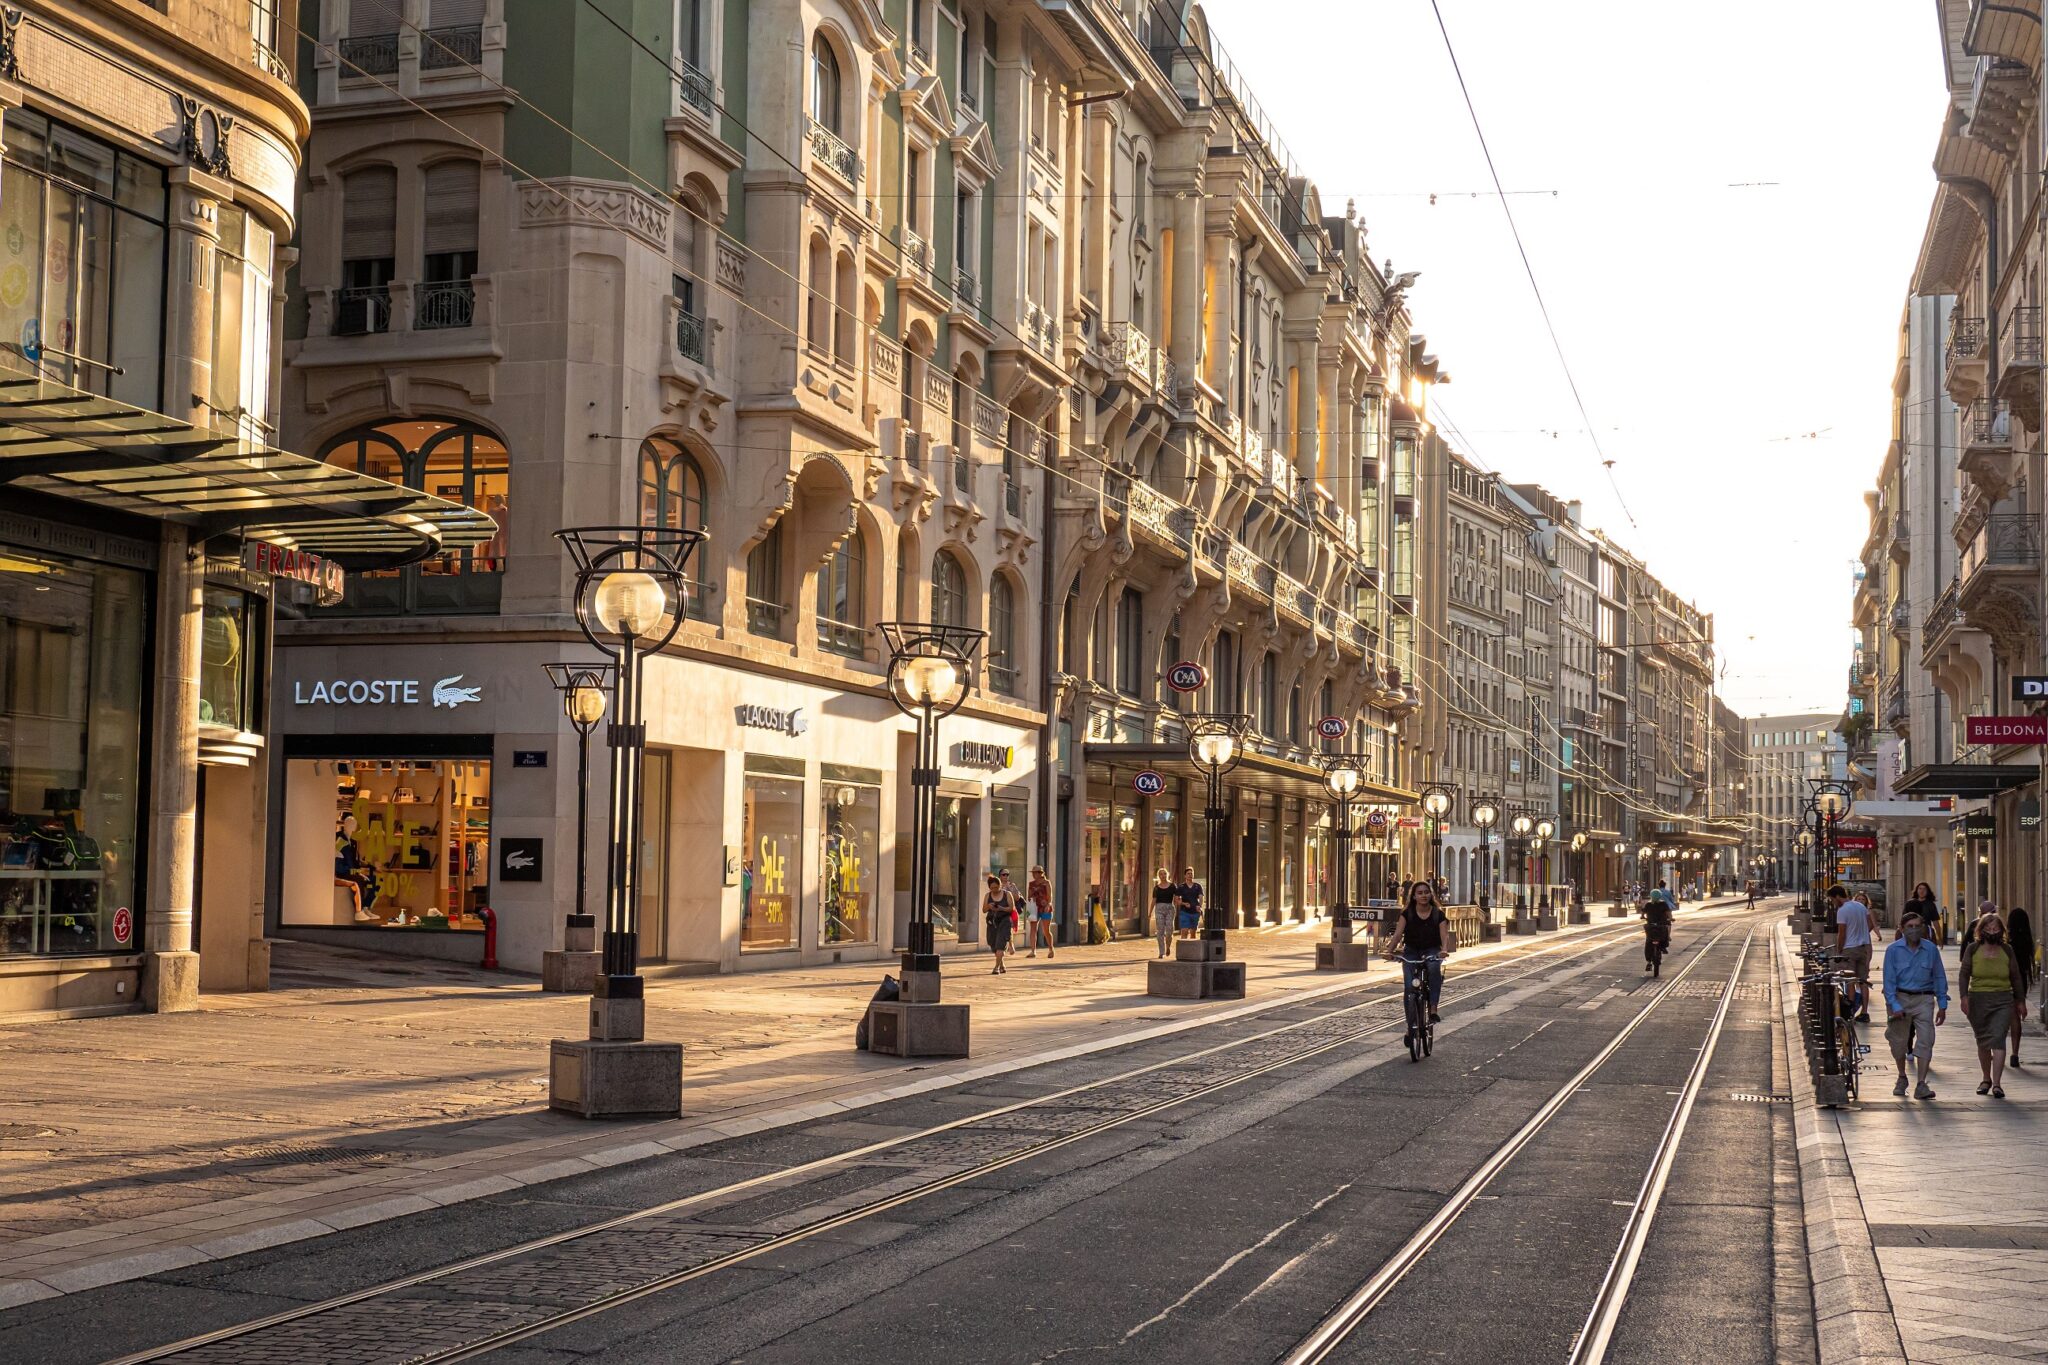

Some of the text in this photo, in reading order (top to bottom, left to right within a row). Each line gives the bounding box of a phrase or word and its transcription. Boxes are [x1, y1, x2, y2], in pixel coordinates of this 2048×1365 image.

[255, 542, 322, 586] FRANZ
[1173, 670, 1198, 684] C&A
[295, 680, 419, 704] LACOSTE
[745, 704, 790, 731] LACOSTE
[1322, 722, 1341, 733] C&A
[1974, 725, 2045, 736] BELDONA
[965, 741, 1006, 768] BLUE LEMON
[1137, 776, 1159, 789] C&A
[352, 798, 420, 865] SALE
[1967, 827, 1994, 835] ESPRIT
[761, 836, 785, 894] SALE
[840, 838, 860, 893] SALE
[765, 901, 784, 923] -50%
[843, 899, 859, 919] -50%
